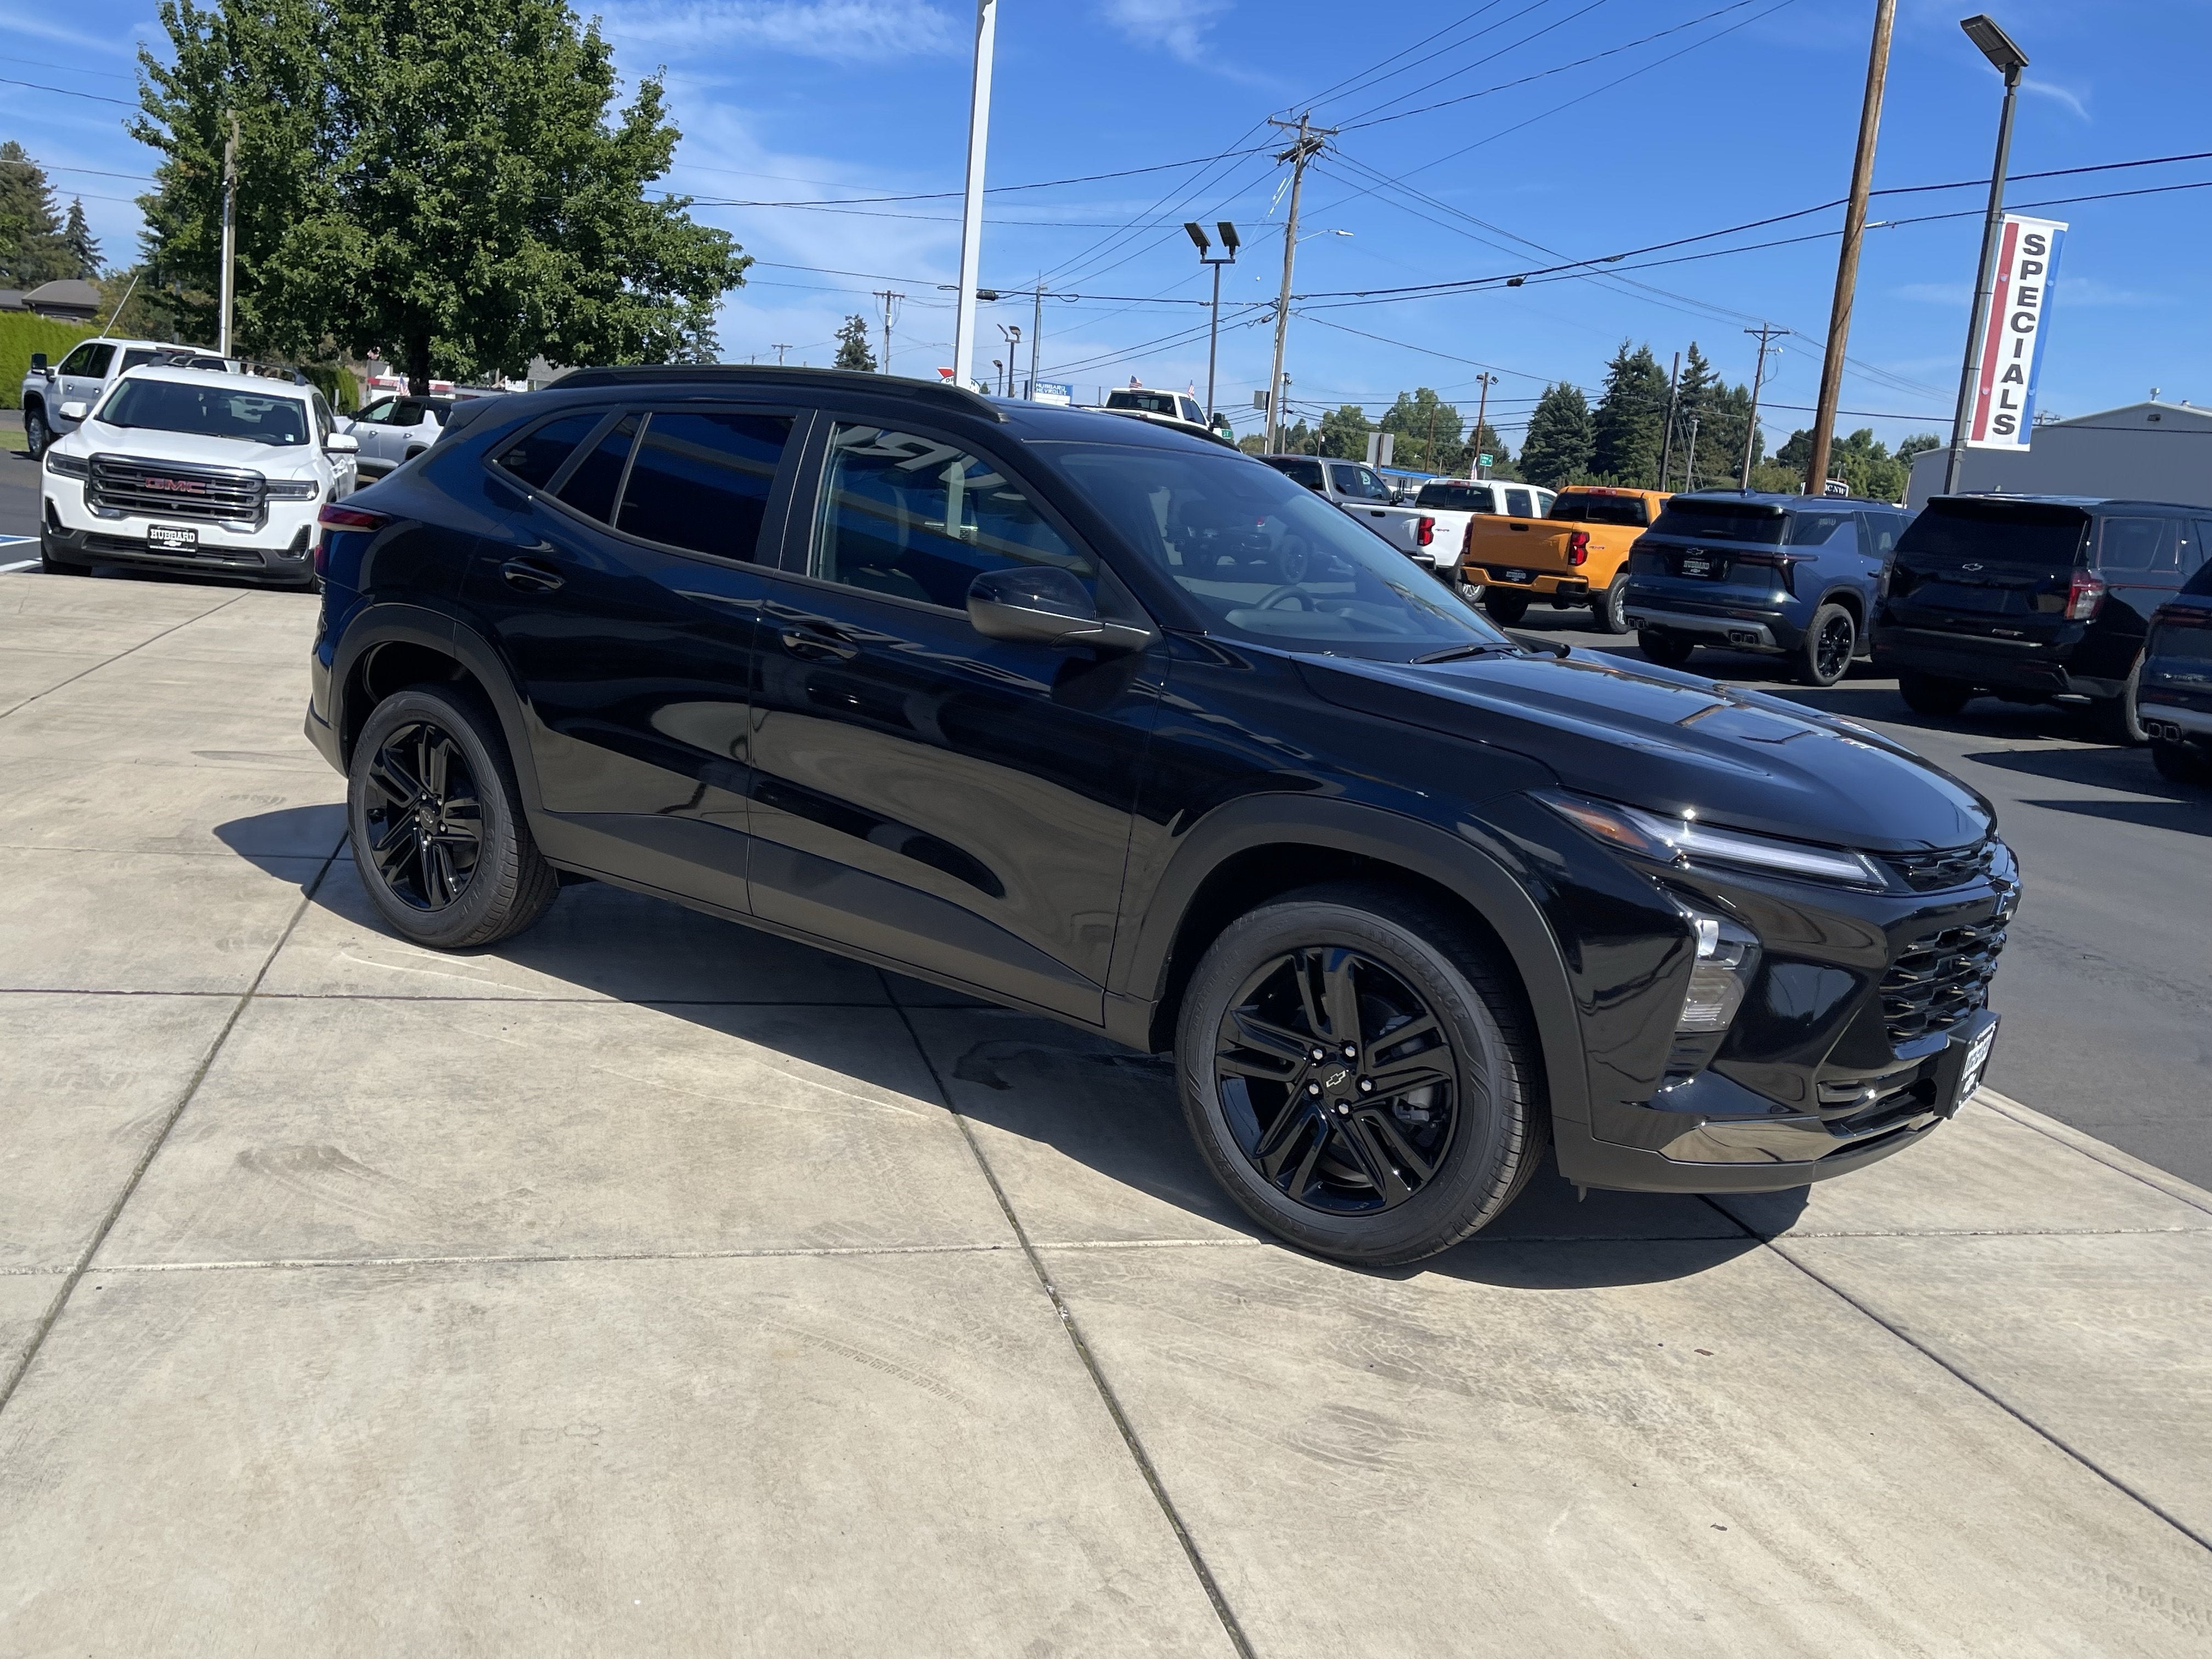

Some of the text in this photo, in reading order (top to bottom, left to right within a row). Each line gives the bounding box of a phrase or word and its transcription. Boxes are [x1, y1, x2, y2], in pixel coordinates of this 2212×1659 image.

[1992, 233, 2046, 436] SPECIALS
[1035, 387, 1067, 396] HEVROLET
[145, 477, 206, 494] GMC
[150, 528, 196, 543] HUBBARD
